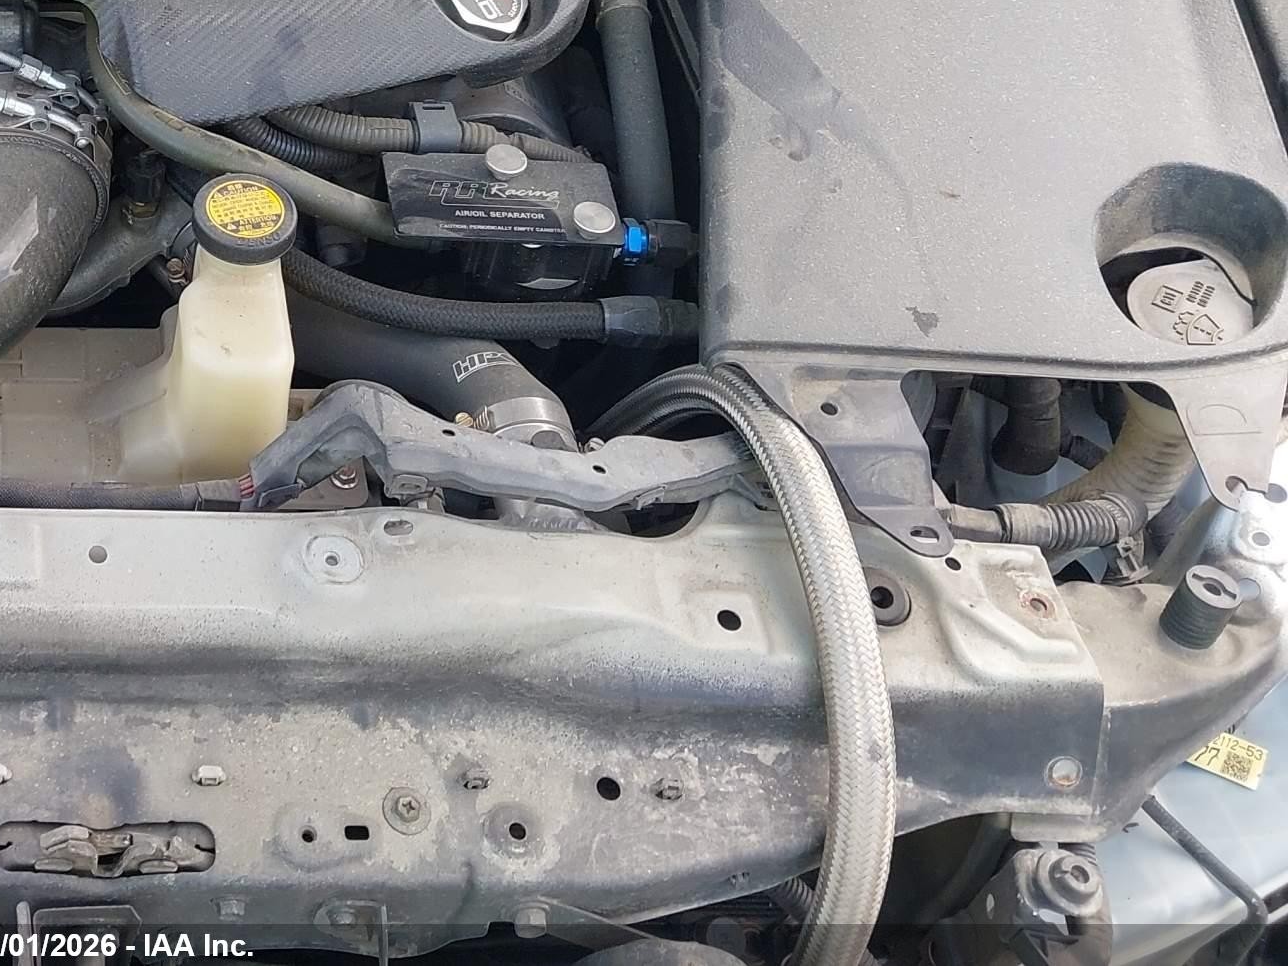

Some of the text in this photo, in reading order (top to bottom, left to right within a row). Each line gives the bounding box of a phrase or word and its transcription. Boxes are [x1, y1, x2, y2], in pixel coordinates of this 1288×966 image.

[490, 181, 560, 201] Racing
[455, 209, 545, 221] AIR/OIL SEPARATOR
